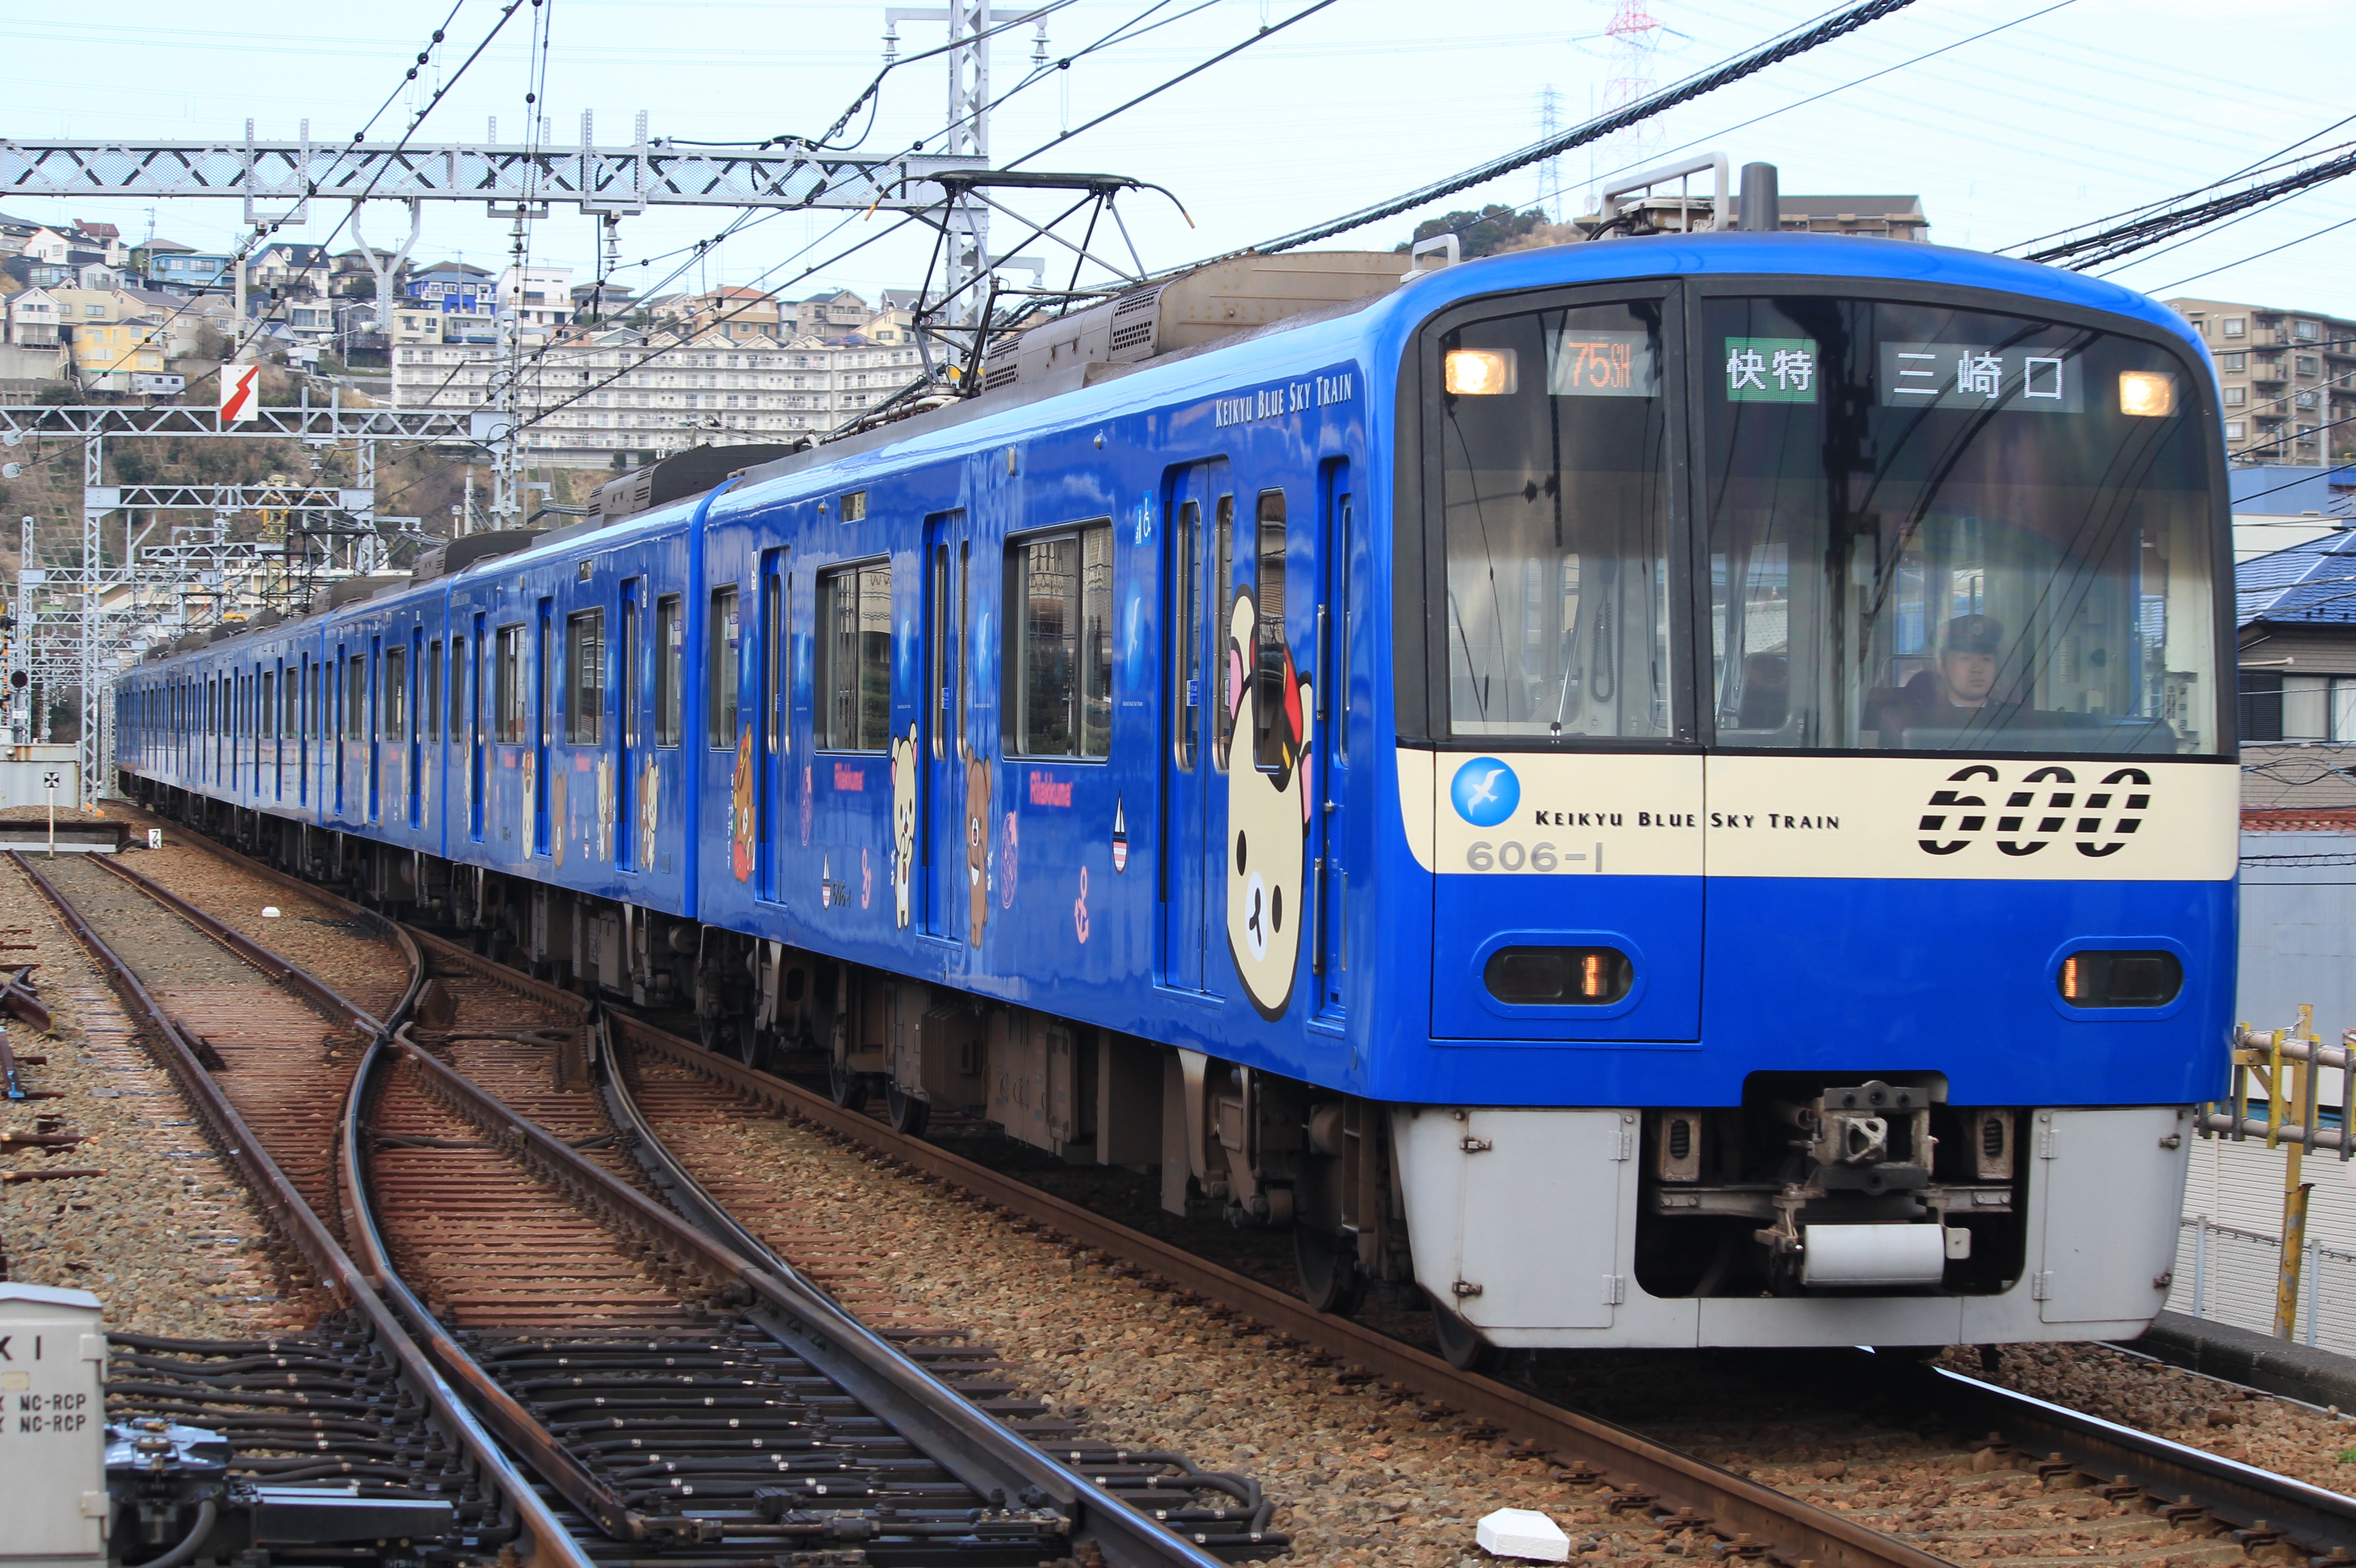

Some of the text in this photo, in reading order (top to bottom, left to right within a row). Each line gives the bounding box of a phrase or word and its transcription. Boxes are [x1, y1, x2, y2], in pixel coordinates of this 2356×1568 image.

[1726, 348, 1813, 391] 快特
[1893, 349, 2063, 400] 三崎口
[1215, 373, 1352, 429] KEIKYU BLUE SKY TRAIN
[1535, 810, 1840, 829] KEIKYU BLUE SKY TRAIN
[1918, 765, 2152, 857] 600
[20, 1394, 87, 1411] NC-RCP
[20, 1414, 87, 1433] NC-RCP
